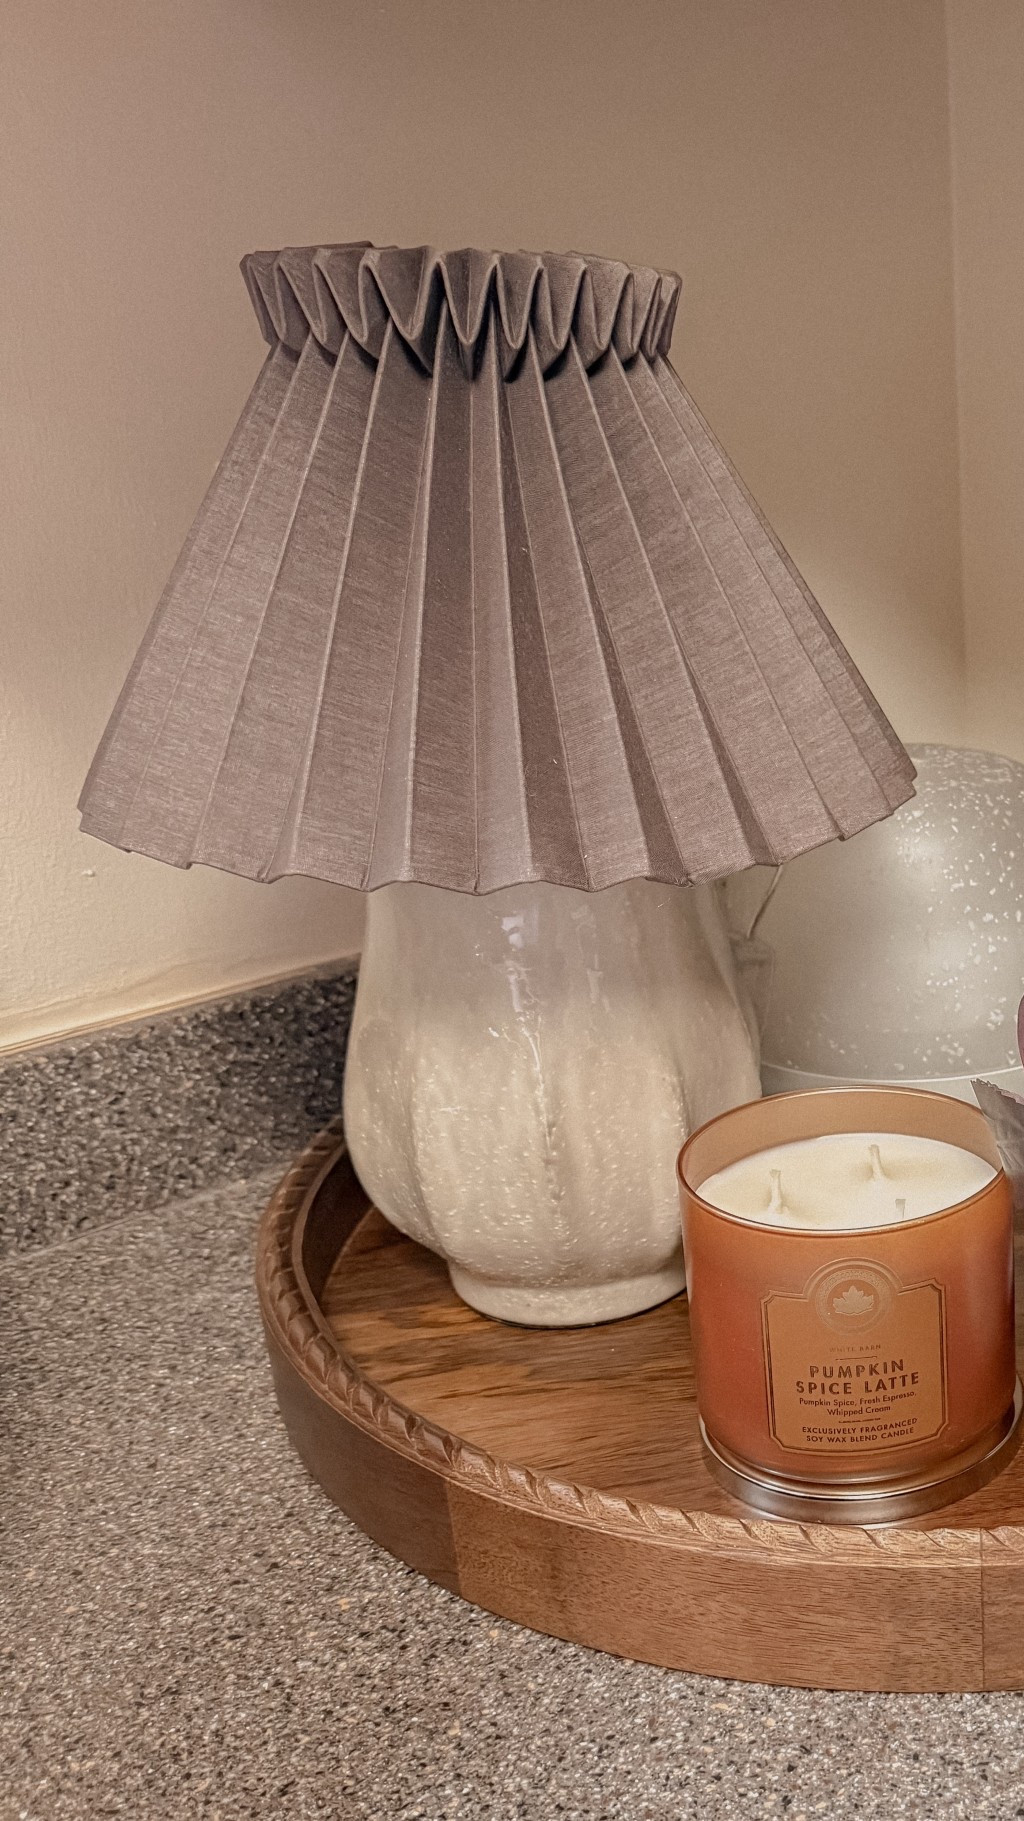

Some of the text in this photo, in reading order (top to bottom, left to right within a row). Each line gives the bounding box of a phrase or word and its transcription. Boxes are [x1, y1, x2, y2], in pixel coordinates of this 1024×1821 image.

[809, 1359, 904, 1379] PUMPKIN
[796, 1372, 919, 1395] SPICE LATTE
[799, 1391, 917, 1408] Pumpkin Spice, Fresh Espresso,
[826, 1405, 891, 1418] Whipped Cream
[802, 1417, 918, 1435] EXCLUSIVELY FRAGRANCED
[806, 1435, 824, 1443] SOY
[850, 1434, 878, 1443] BLEND
[881, 1426, 914, 1440] CANDLE
